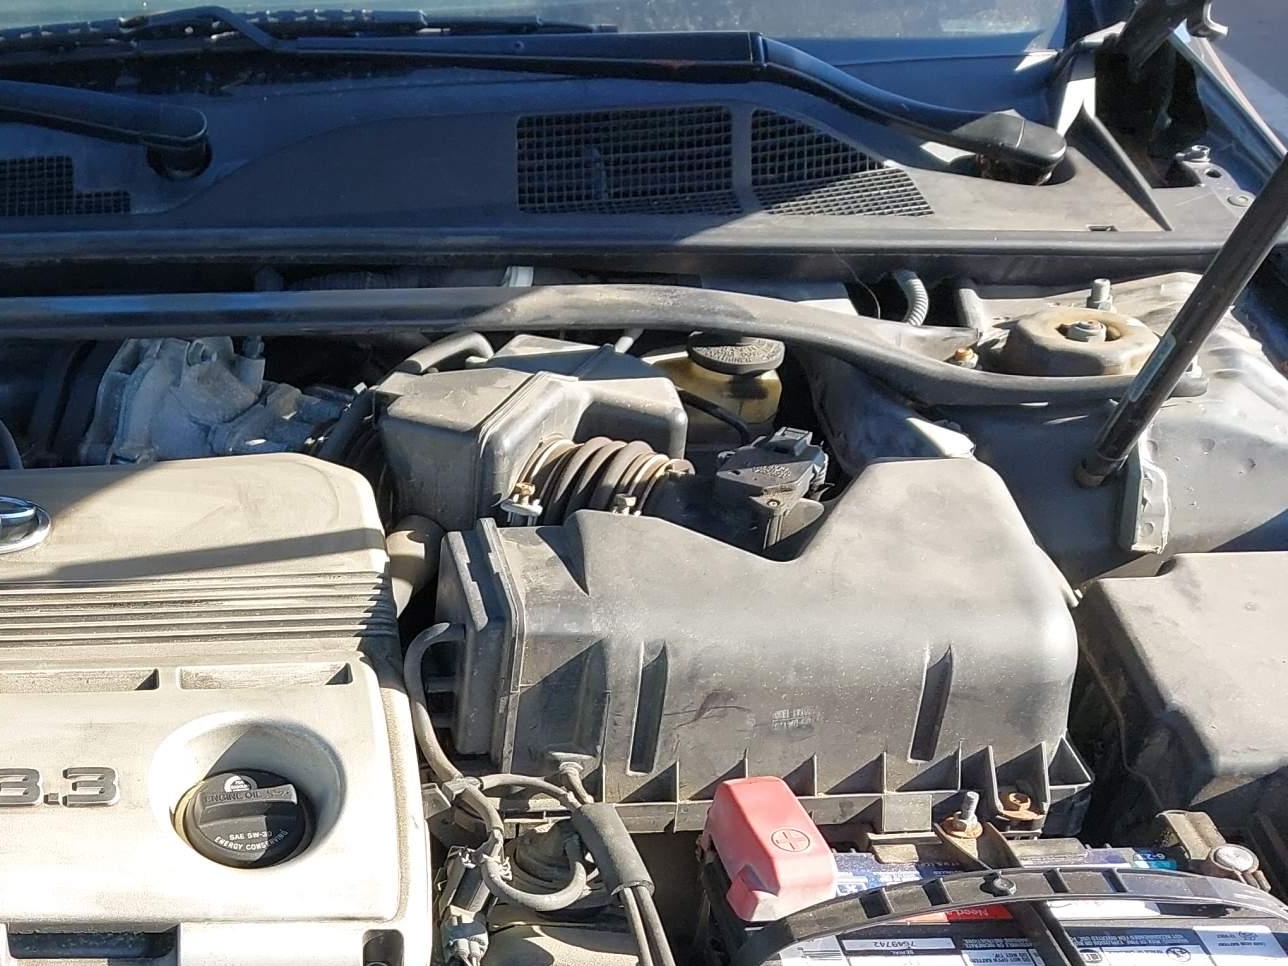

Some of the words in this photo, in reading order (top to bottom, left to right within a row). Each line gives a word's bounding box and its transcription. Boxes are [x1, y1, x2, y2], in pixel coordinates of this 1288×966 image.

[203, 791, 241, 803] ENGINE
[244, 790, 261, 800] OIL
[214, 836, 244, 850] ENERGY
[245, 829, 289, 851] CONSERVING
[228, 833, 245, 841] SAE
[247, 831, 273, 839] 5W-30
